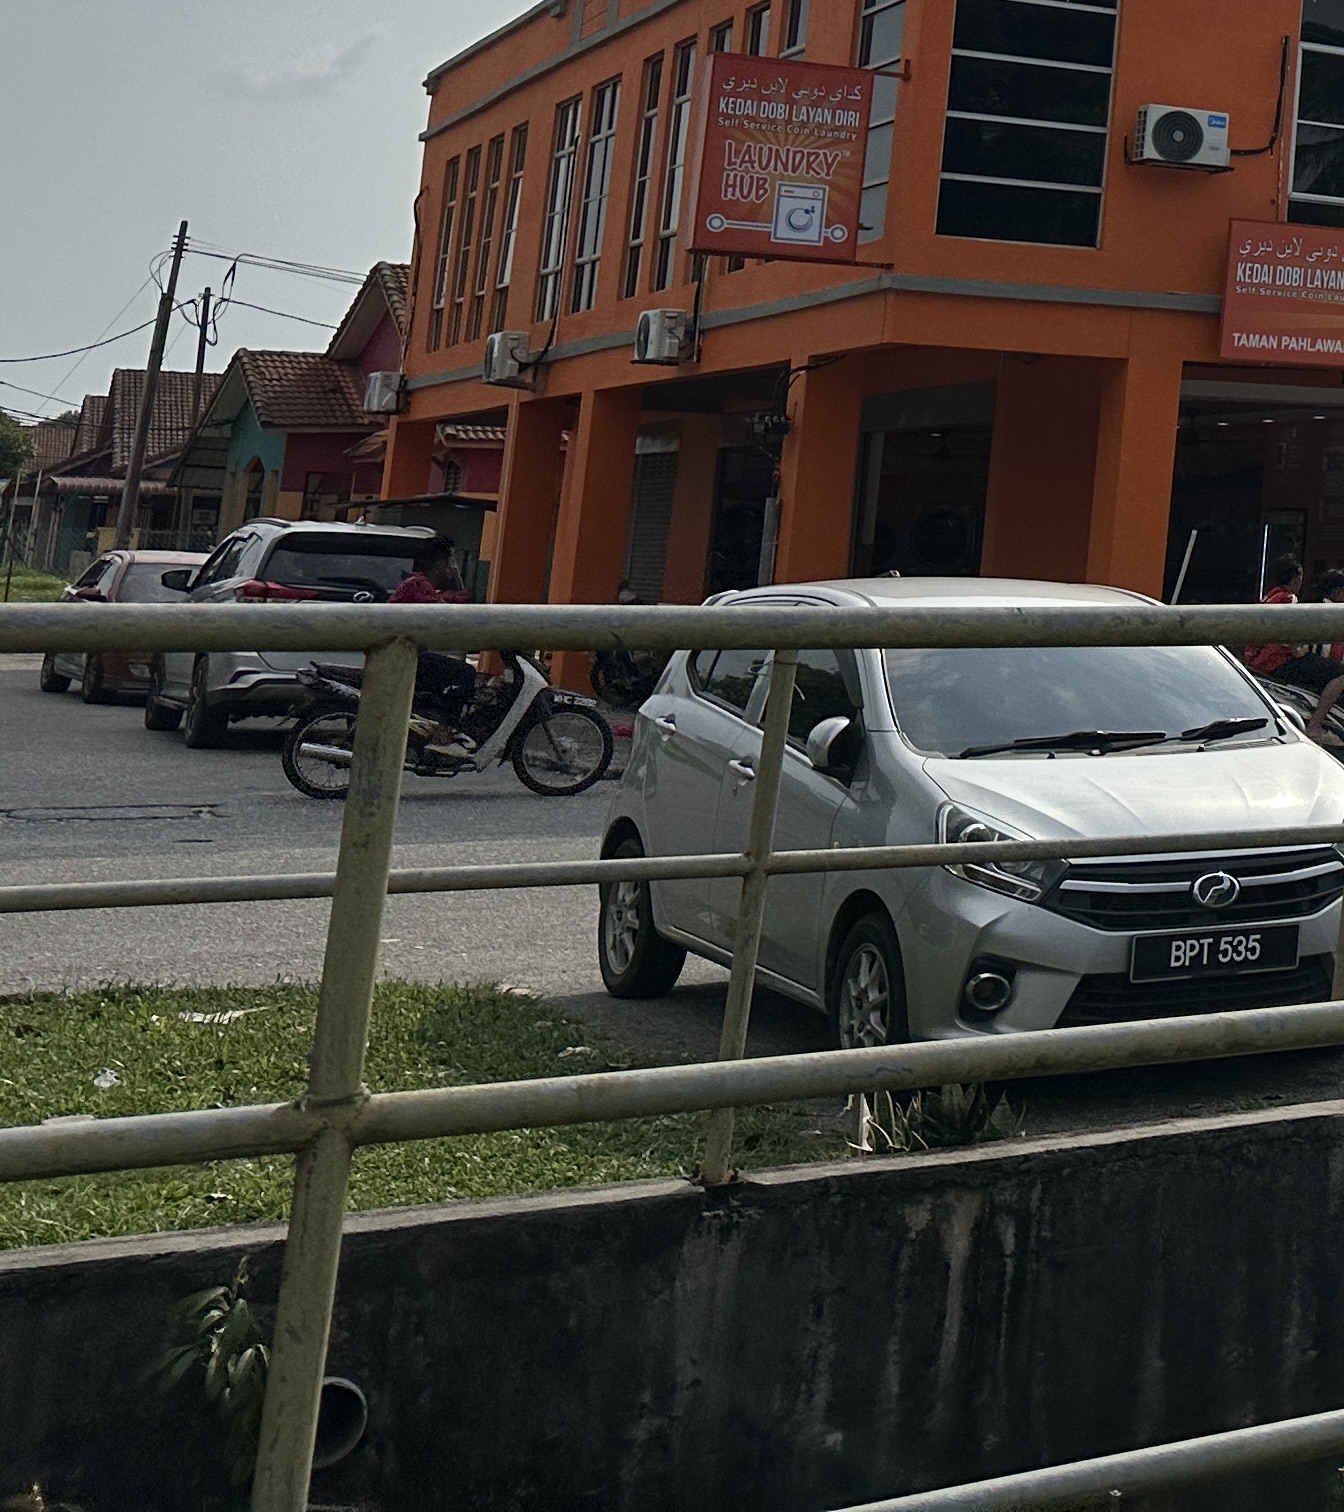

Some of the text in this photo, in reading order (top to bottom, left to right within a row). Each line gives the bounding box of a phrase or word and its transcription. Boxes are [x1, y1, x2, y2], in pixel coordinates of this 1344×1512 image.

[719, 96, 860, 128] KEDAI DOBI LAYAN DIRI
[718, 116, 857, 142] Self Service Coin Laundry
[724, 139, 842, 180] LAUNDRY
[721, 170, 770, 204] HUB
[1236, 262, 1274, 285] KEDAI
[1276, 266, 1305, 287] DOBI
[1235, 285, 1256, 294] Self
[1259, 287, 1298, 298] Service
[1301, 290, 1324, 300] Coin
[1232, 332, 1278, 349] TAMAN
[1170, 934, 1261, 967] BPT 535
